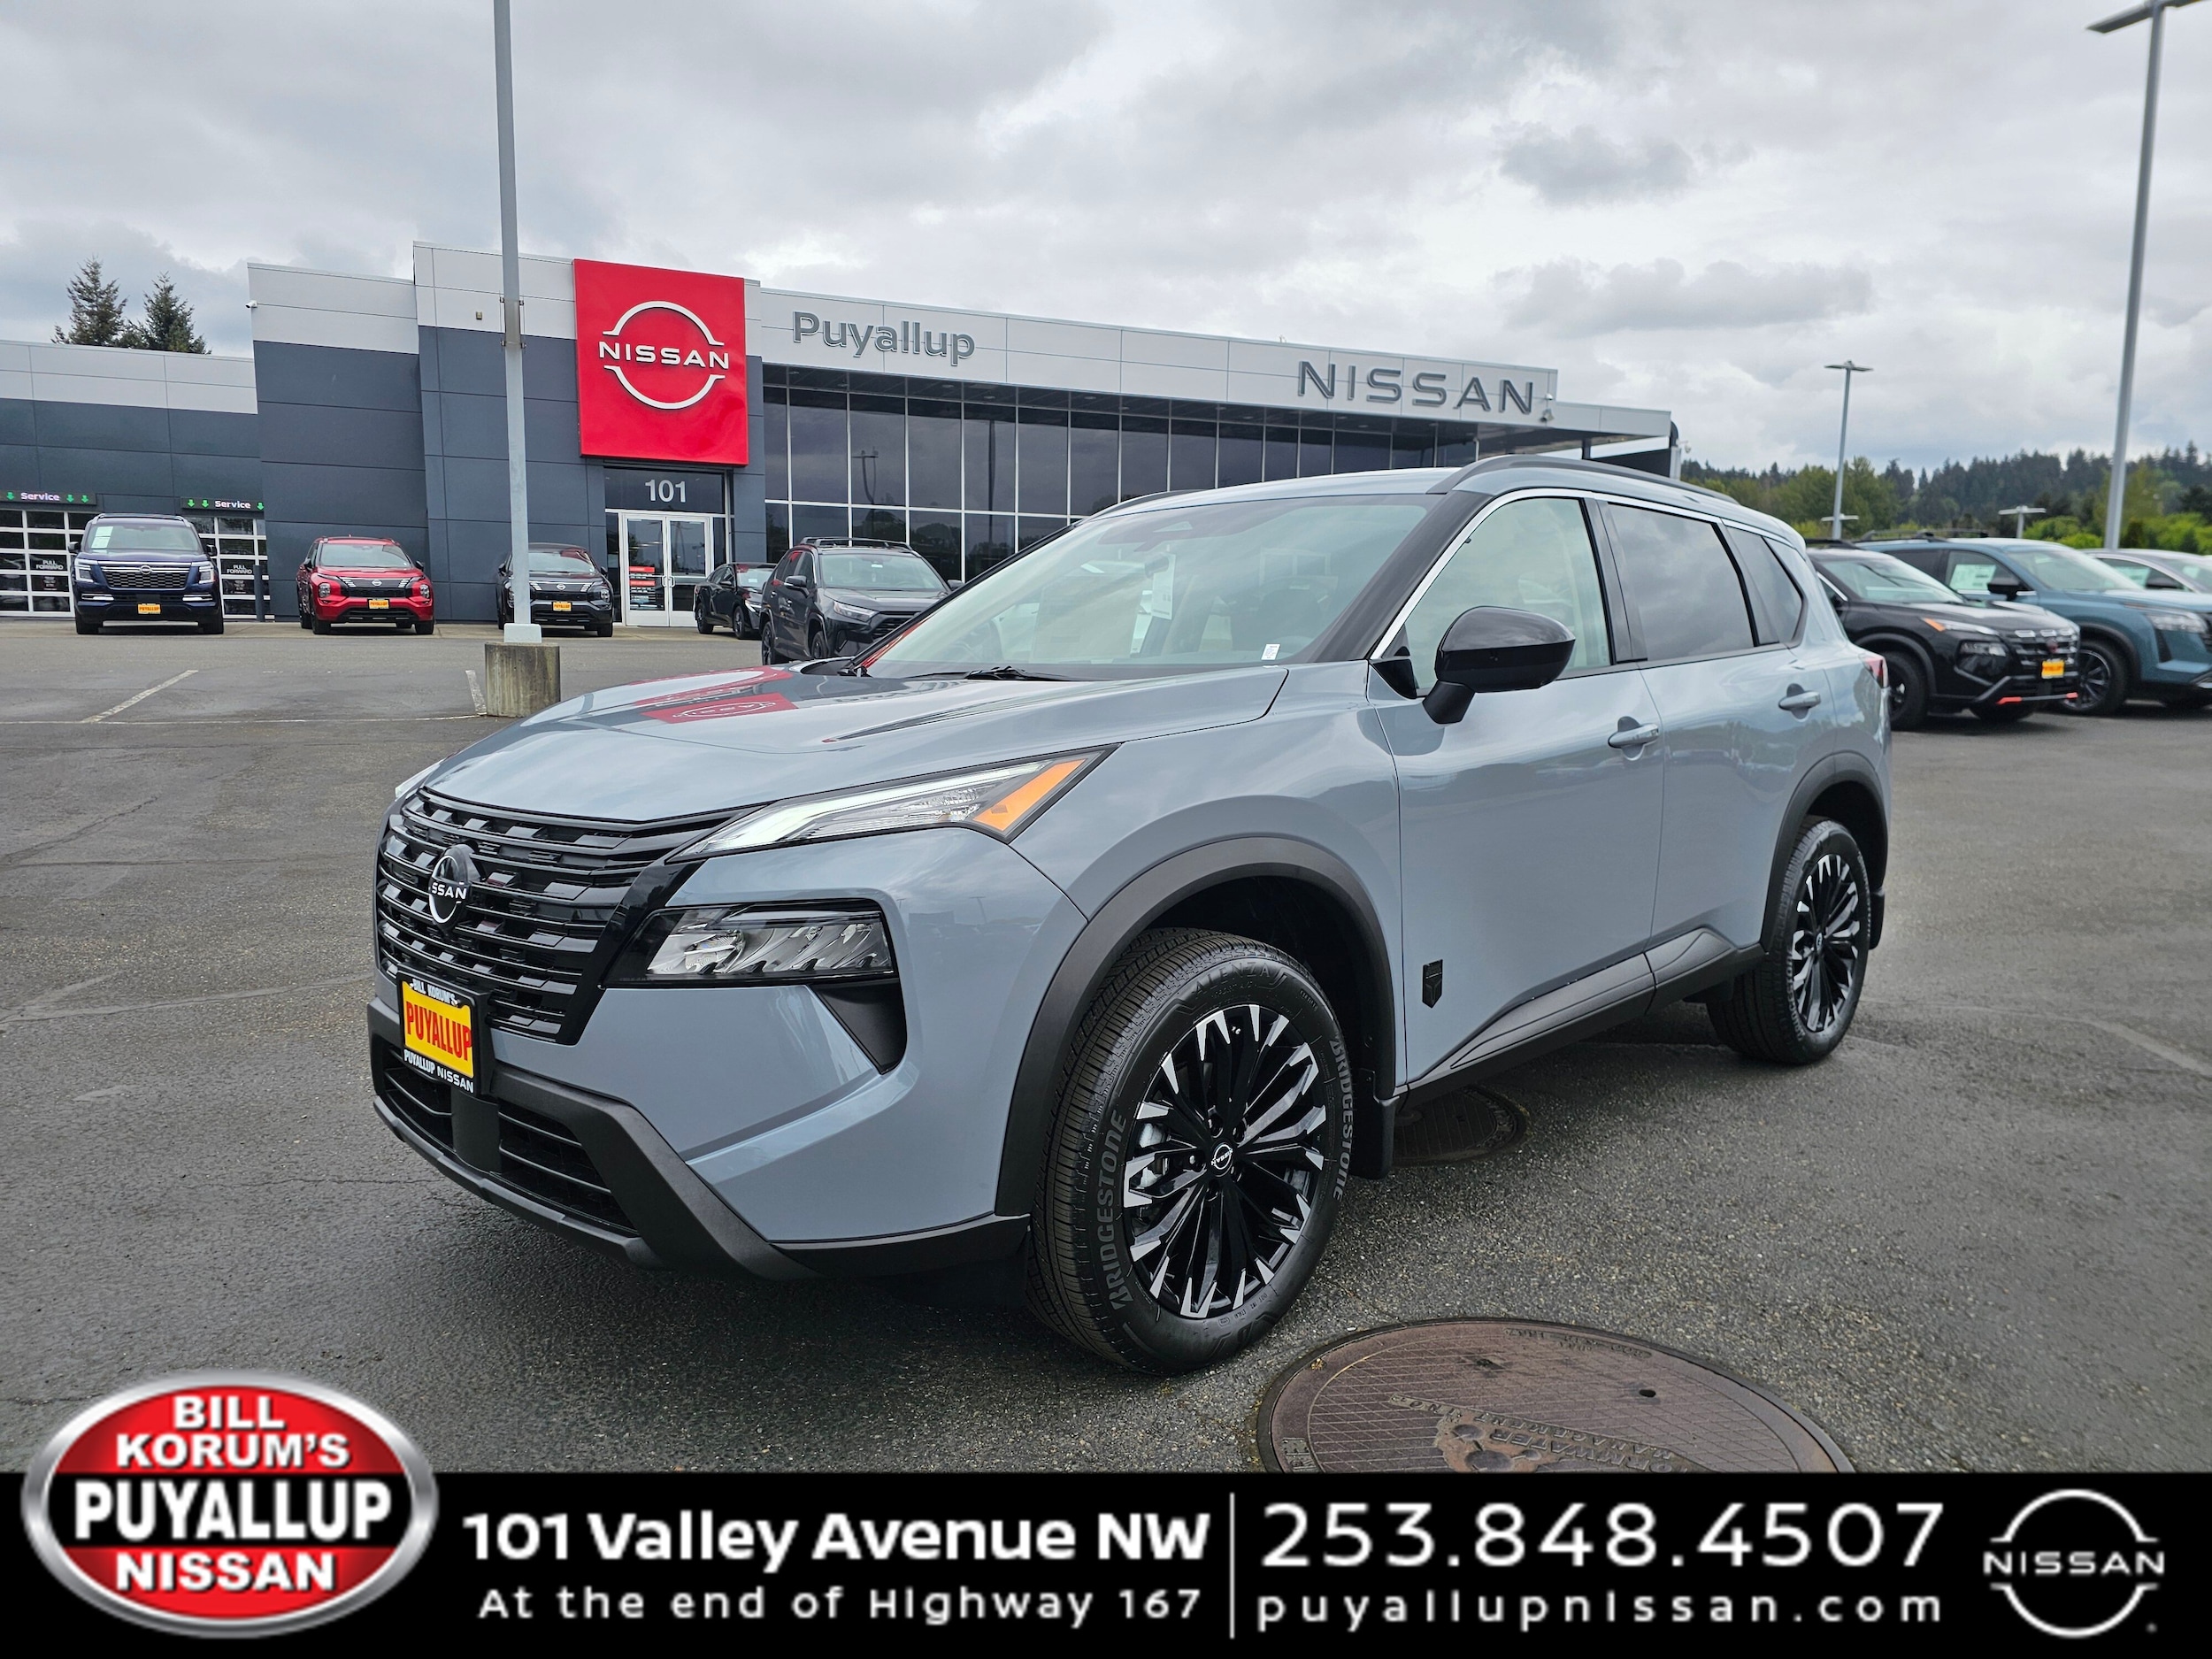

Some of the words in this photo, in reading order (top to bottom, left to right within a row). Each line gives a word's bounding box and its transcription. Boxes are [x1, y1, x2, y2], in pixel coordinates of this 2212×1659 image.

[598, 342, 729, 369] NISSAN
[793, 311, 975, 366] Puyallup
[1298, 361, 1533, 414] NISSAN
[20, 492, 60, 501] Service
[214, 500, 251, 509] Service
[645, 480, 686, 503] 101
[406, 1001, 472, 1062] PUYALLUP
[403, 1049, 435, 1074] PUYALLUP
[437, 1066, 474, 1094] NISSAN
[1329, 1039, 1354, 1202] BRIDGESTONE
[1096, 1109, 1133, 1310] BRIDGESTONE
